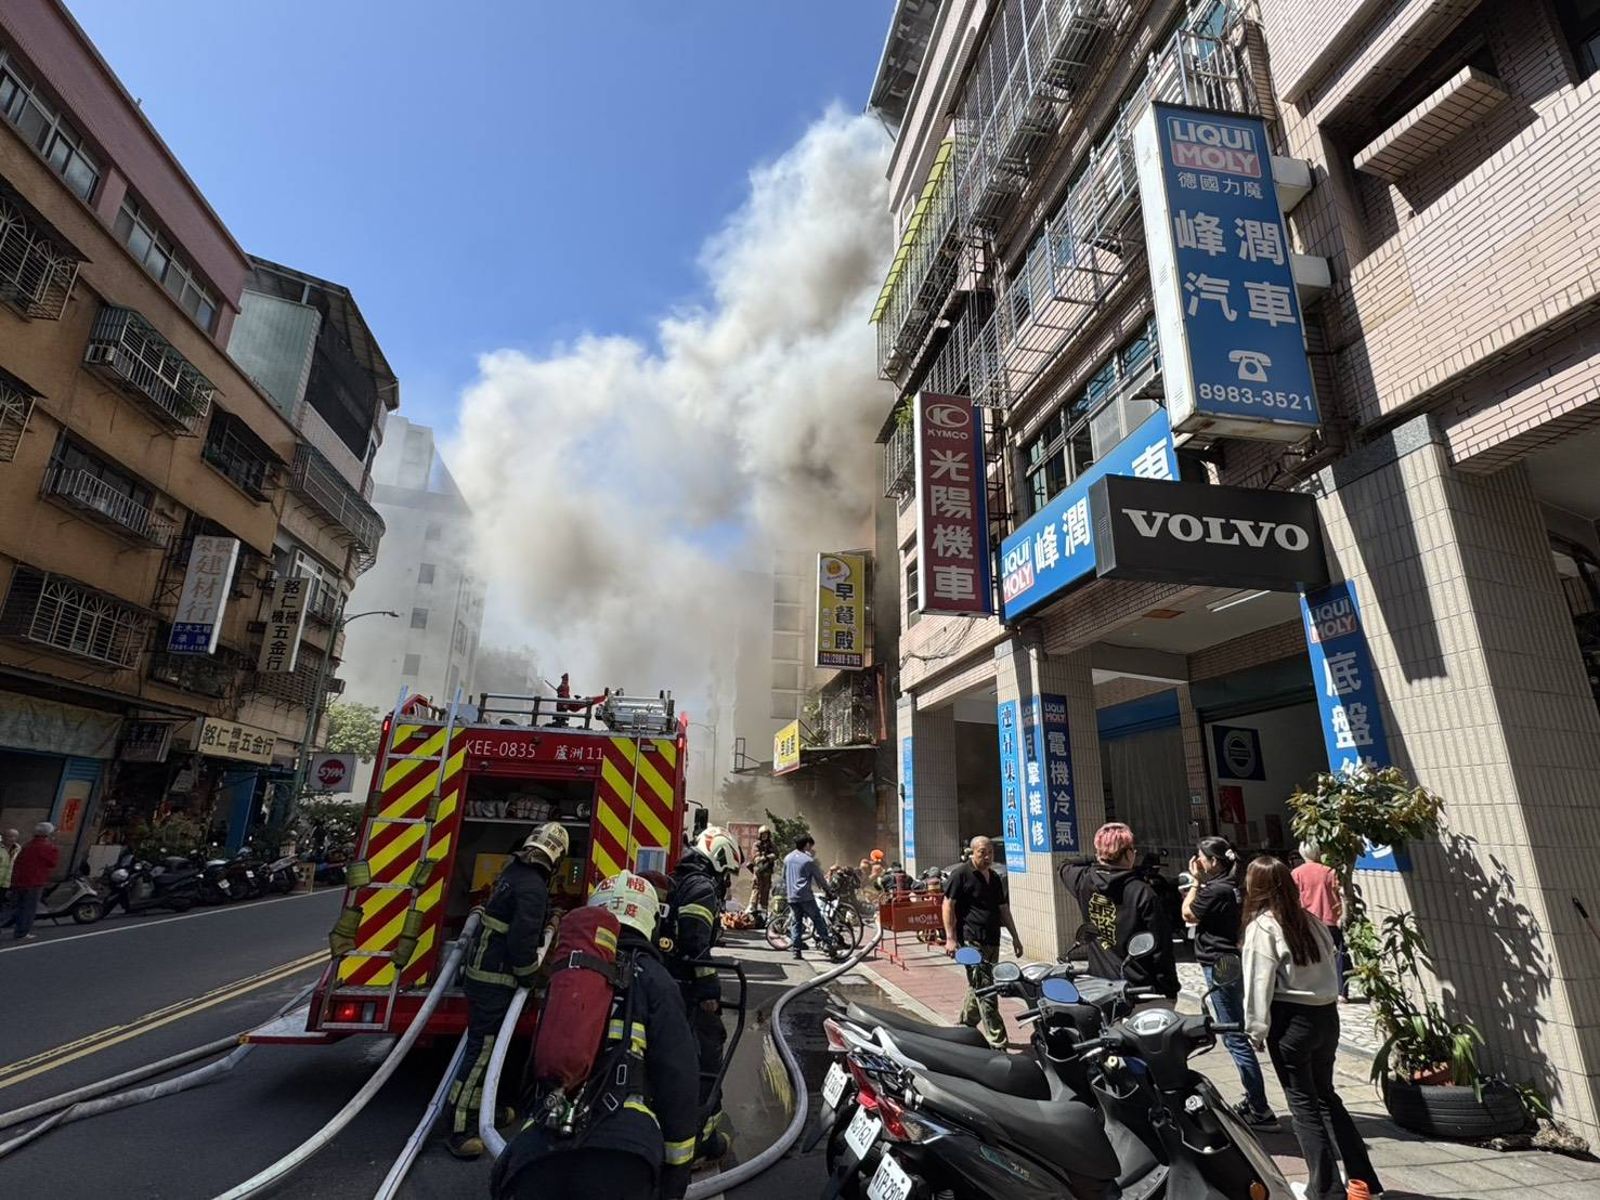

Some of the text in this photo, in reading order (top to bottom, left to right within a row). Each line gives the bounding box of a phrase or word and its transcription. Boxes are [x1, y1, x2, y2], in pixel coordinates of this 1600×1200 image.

[1172, 119, 1253, 152] LIQUI
[1174, 143, 1260, 175] MOLY
[1178, 172, 1264, 200] 德國力魔
[1174, 209, 1286, 267] 峰潤
[1184, 271, 1297, 328] 汽車
[1198, 382, 1314, 412] 8983-3521
[927, 427, 969, 441] KYMCO
[930, 448, 977, 601] 光陽機車
[1121, 508, 1310, 551] VOLVO
[1002, 541, 1030, 579] IQUI
[834, 582, 856, 651] 早餐殿
[1307, 596, 1351, 625] LIQUI
[1310, 614, 1354, 643] MOLY
[465, 739, 536, 758] KEE-0835
[319, 767, 344, 780] SYM
[1048, 731, 1075, 846] 電機冷氣
